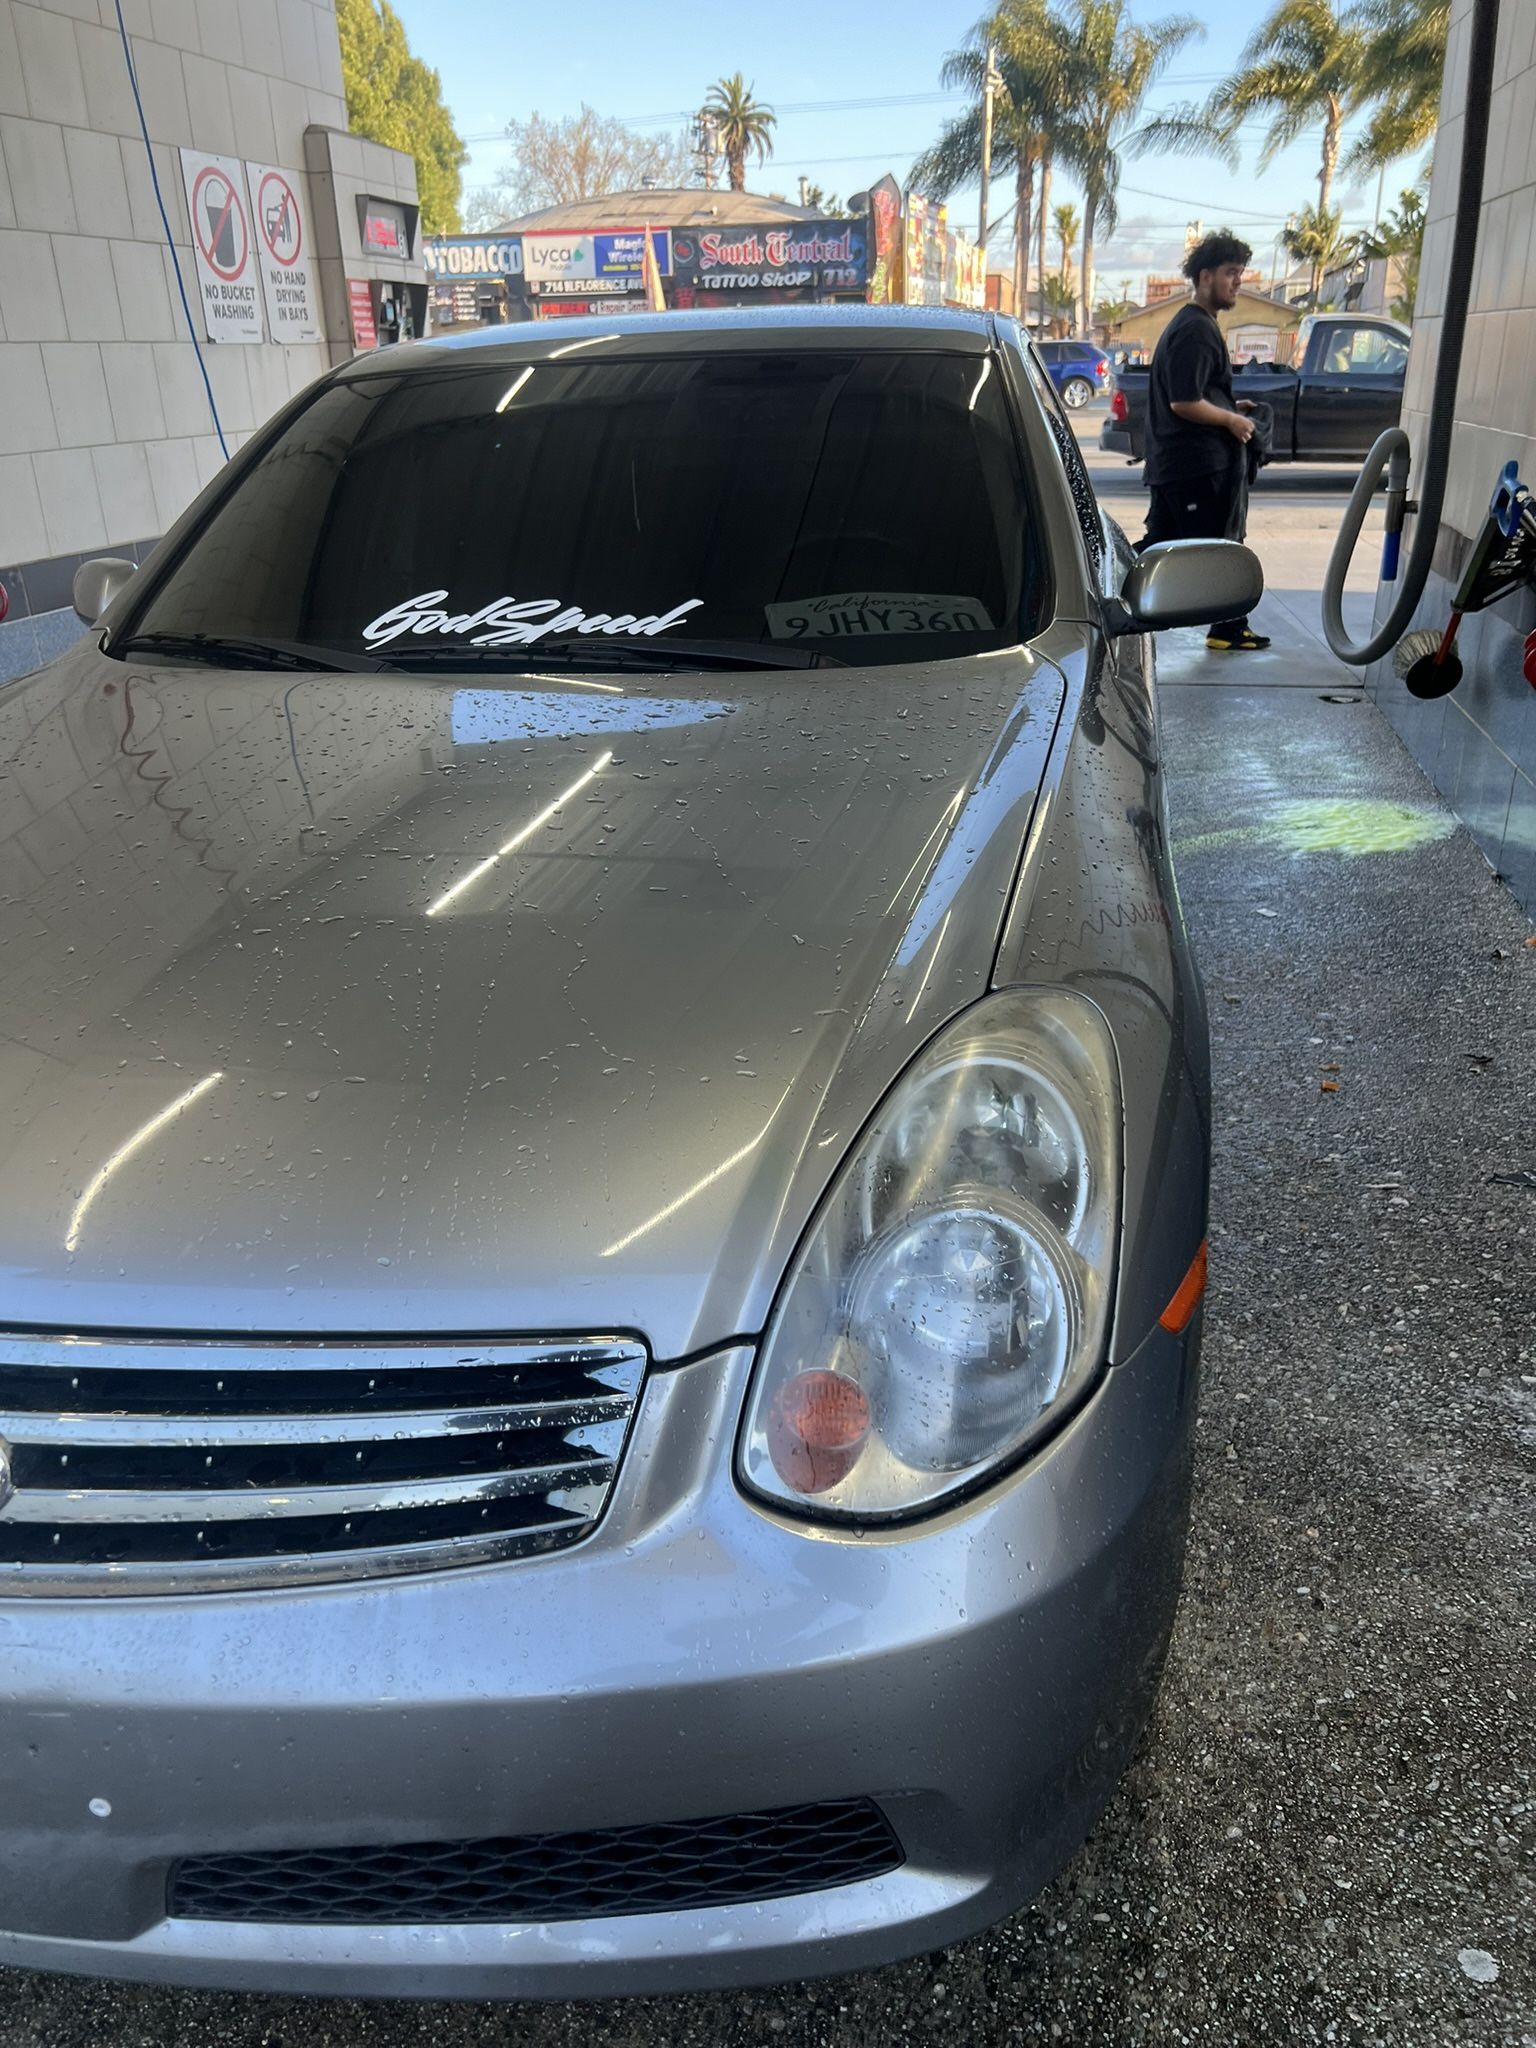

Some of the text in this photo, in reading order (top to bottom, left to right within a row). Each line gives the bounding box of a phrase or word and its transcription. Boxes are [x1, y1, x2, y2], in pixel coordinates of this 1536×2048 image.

[531, 247, 571, 265] Lyca
[701, 227, 853, 269] South Central
[438, 244, 523, 274] TOBACCO
[271, 271, 306, 285] NO HAND
[823, 269, 856, 286] 712
[205, 284, 255, 300] NO BUCKET
[545, 282, 563, 293] 714
[276, 289, 305, 303] DRYING
[212, 304, 254, 319] WASHING
[278, 307, 309, 321] IN BAYS
[808, 596, 940, 613] California
